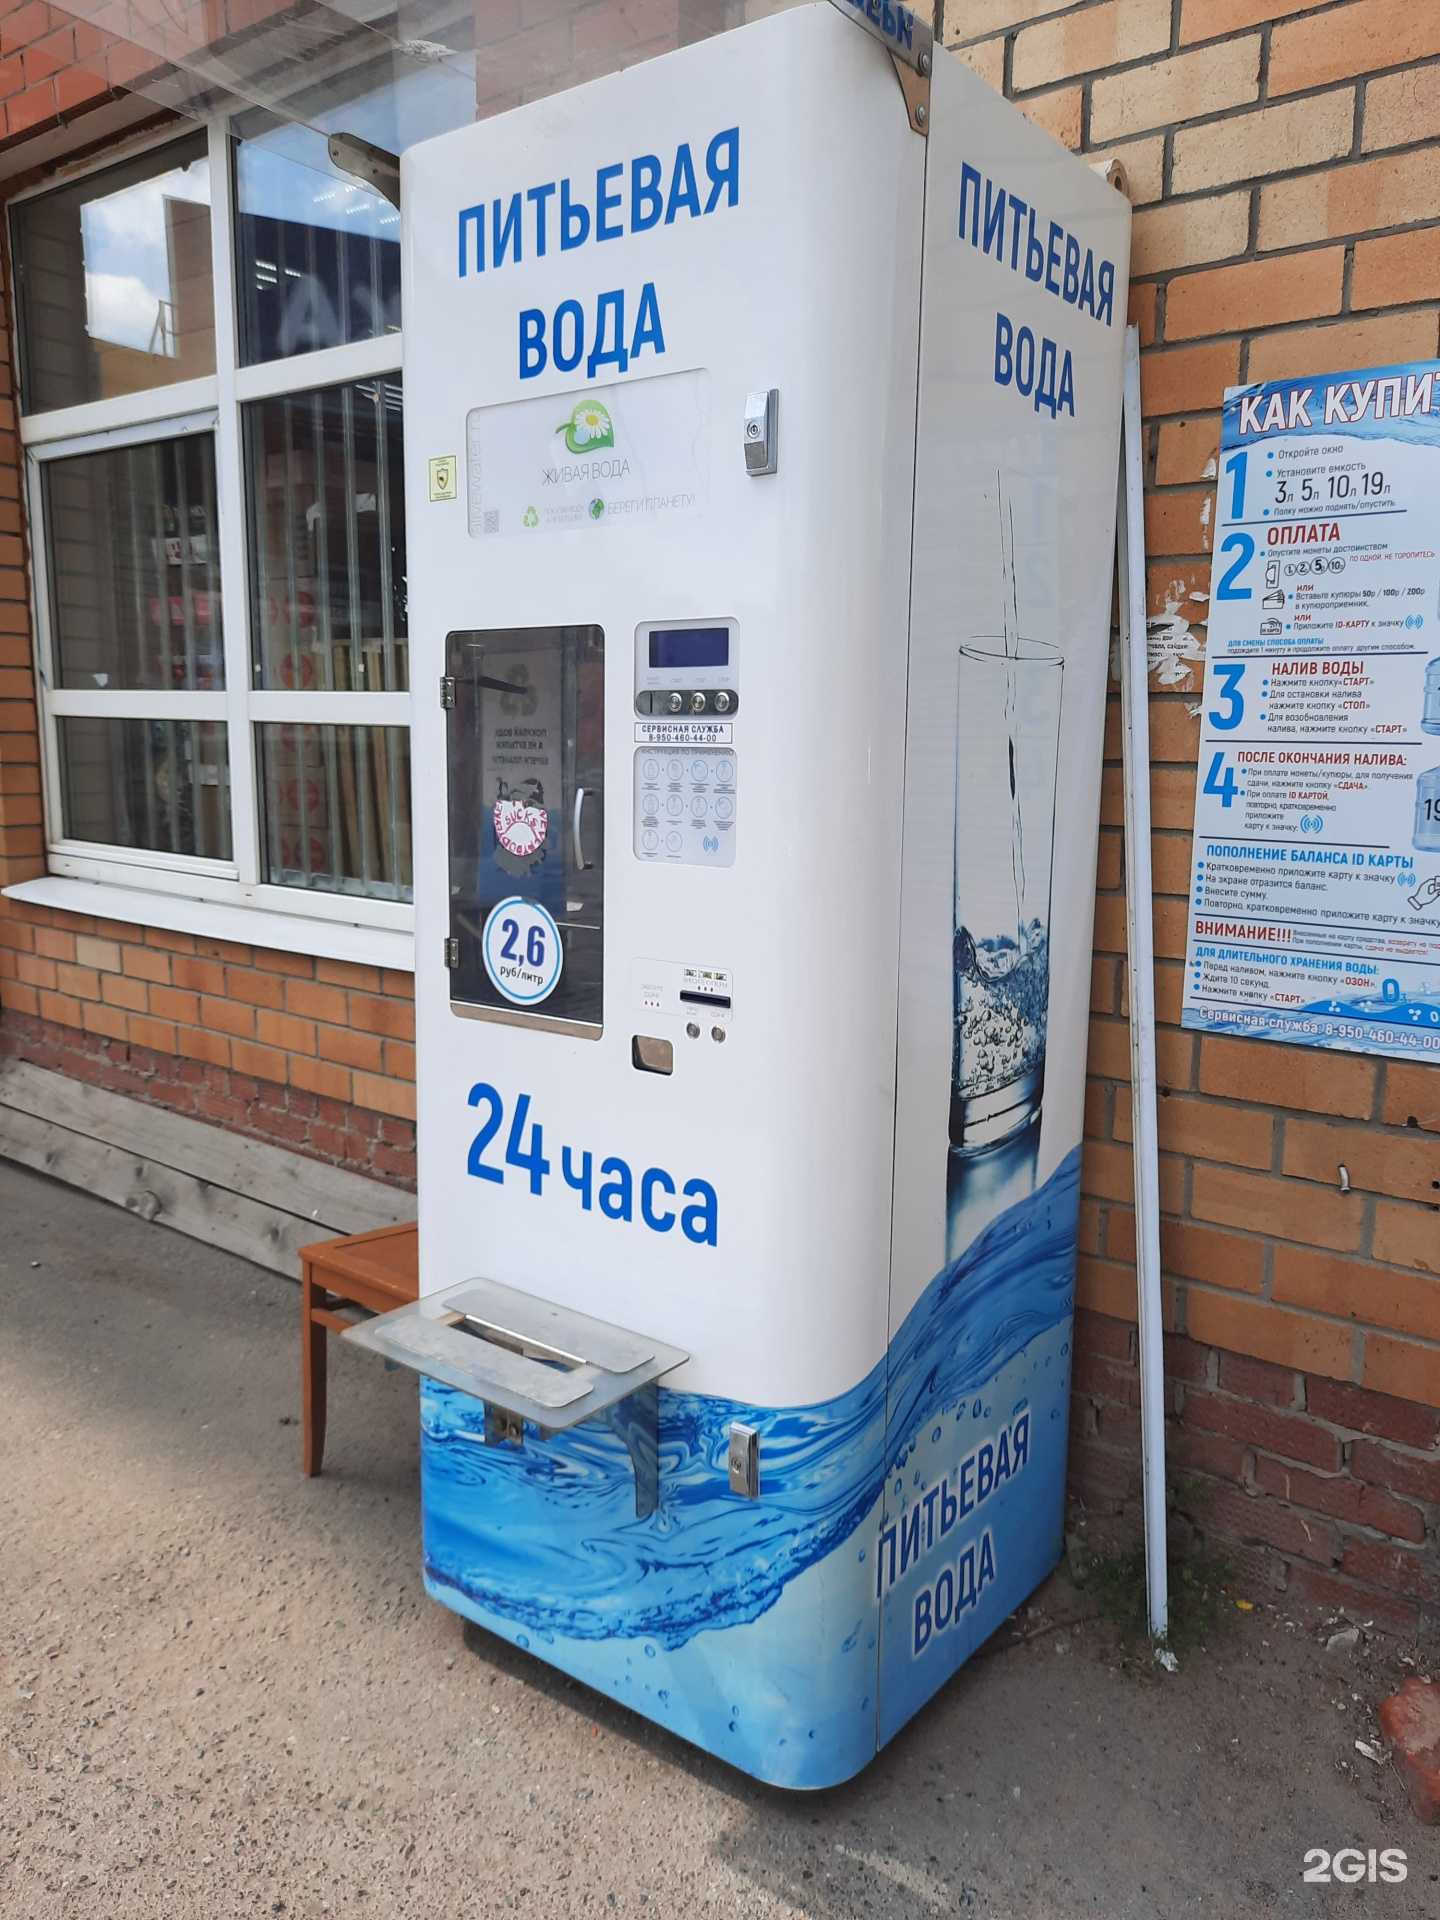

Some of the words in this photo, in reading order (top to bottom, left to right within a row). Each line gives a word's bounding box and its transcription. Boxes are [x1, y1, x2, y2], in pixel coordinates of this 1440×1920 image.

[458, 127, 740, 277] ПИТЬЕВАЯ
[958, 162, 1115, 326] ПИТЬЕВАЯ
[518, 281, 666, 379] ВОДА
[995, 313, 1075, 420] ВОДА
[1239, 388, 1313, 434] КАК
[1323, 372, 1440, 425] КУПИ
[1278, 446, 1319, 459] Откройте
[1322, 446, 1344, 454] окно
[542, 463, 589, 485] ЖИВАЯ
[592, 458, 630, 480] ВОДА
[1276, 466, 1326, 478] Установите
[1328, 462, 1366, 474] емкость
[1225, 451, 1248, 519] 1
[1267, 523, 1340, 546] ОПЛАТА
[1216, 532, 1254, 600] 2
[1330, 591, 1361, 600] купюры
[1272, 662, 1318, 675] НАЛИВ
[1322, 660, 1364, 676] ВОДЫ
[1208, 664, 1246, 730] 3
[1270, 690, 1284, 698] Для
[1268, 713, 1283, 722] Для
[1306, 703, 1336, 712] кнопку
[692, 726, 724, 734] СЛУЖБА
[1338, 726, 1368, 735] кнопку
[1238, 752, 1275, 762] ПОСЛЕ
[1278, 752, 1350, 764] ОКОНЧАНИЯ
[1203, 752, 1238, 808] 4
[1248, 768, 1262, 776] При
[1246, 790, 1260, 798] При
[1244, 822, 1264, 831] карту
[1245, 812, 1284, 820] приложите
[1206, 844, 1287, 860] ПОПОЛНЕНИЕ
[1291, 850, 1348, 865] БАЛАНСА
[1352, 854, 1364, 866] ID
[1368, 855, 1414, 868] КАРТЫ
[1206, 862, 1276, 875] Кратковременно
[1278, 868, 1326, 878] приложите
[1328, 872, 1352, 881] карту
[1364, 874, 1396, 884] значку
[1206, 874, 1216, 882] На
[1218, 878, 1248, 886] экране
[1250, 880, 1292, 889] отразится
[1204, 886, 1238, 896] Внесите
[1246, 903, 1318, 916] кратковременно
[1320, 910, 1370, 921] приложите
[1372, 914, 1398, 925] карту
[1195, 920, 1291, 942] ВНИМАНИЕ!!!
[500, 918, 545, 967] 2,6
[1196, 947, 1216, 957] ДЛЯ
[1218, 948, 1288, 965] ДЛИТЕЛЬНОГО
[1290, 956, 1342, 970] ХРАНЕНИЯ
[500, 965, 544, 986] руб/литр
[1203, 973, 1228, 984] Ждите
[1230, 976, 1238, 984] 10
[1204, 961, 1228, 972] Перед
[1268, 970, 1306, 980] нажмите
[1308, 974, 1338, 985] кнопку
[1202, 985, 1238, 996] Нажмите
[1240, 990, 1268, 1000] кнопку
[1200, 1006, 1265, 1027] Сервисная
[466, 1081, 551, 1196] 24
[561, 1145, 718, 1248] часа
[876, 1411, 1032, 1600] ПИТЬЕВАЯ
[914, 1535, 996, 1657] ВОДА
